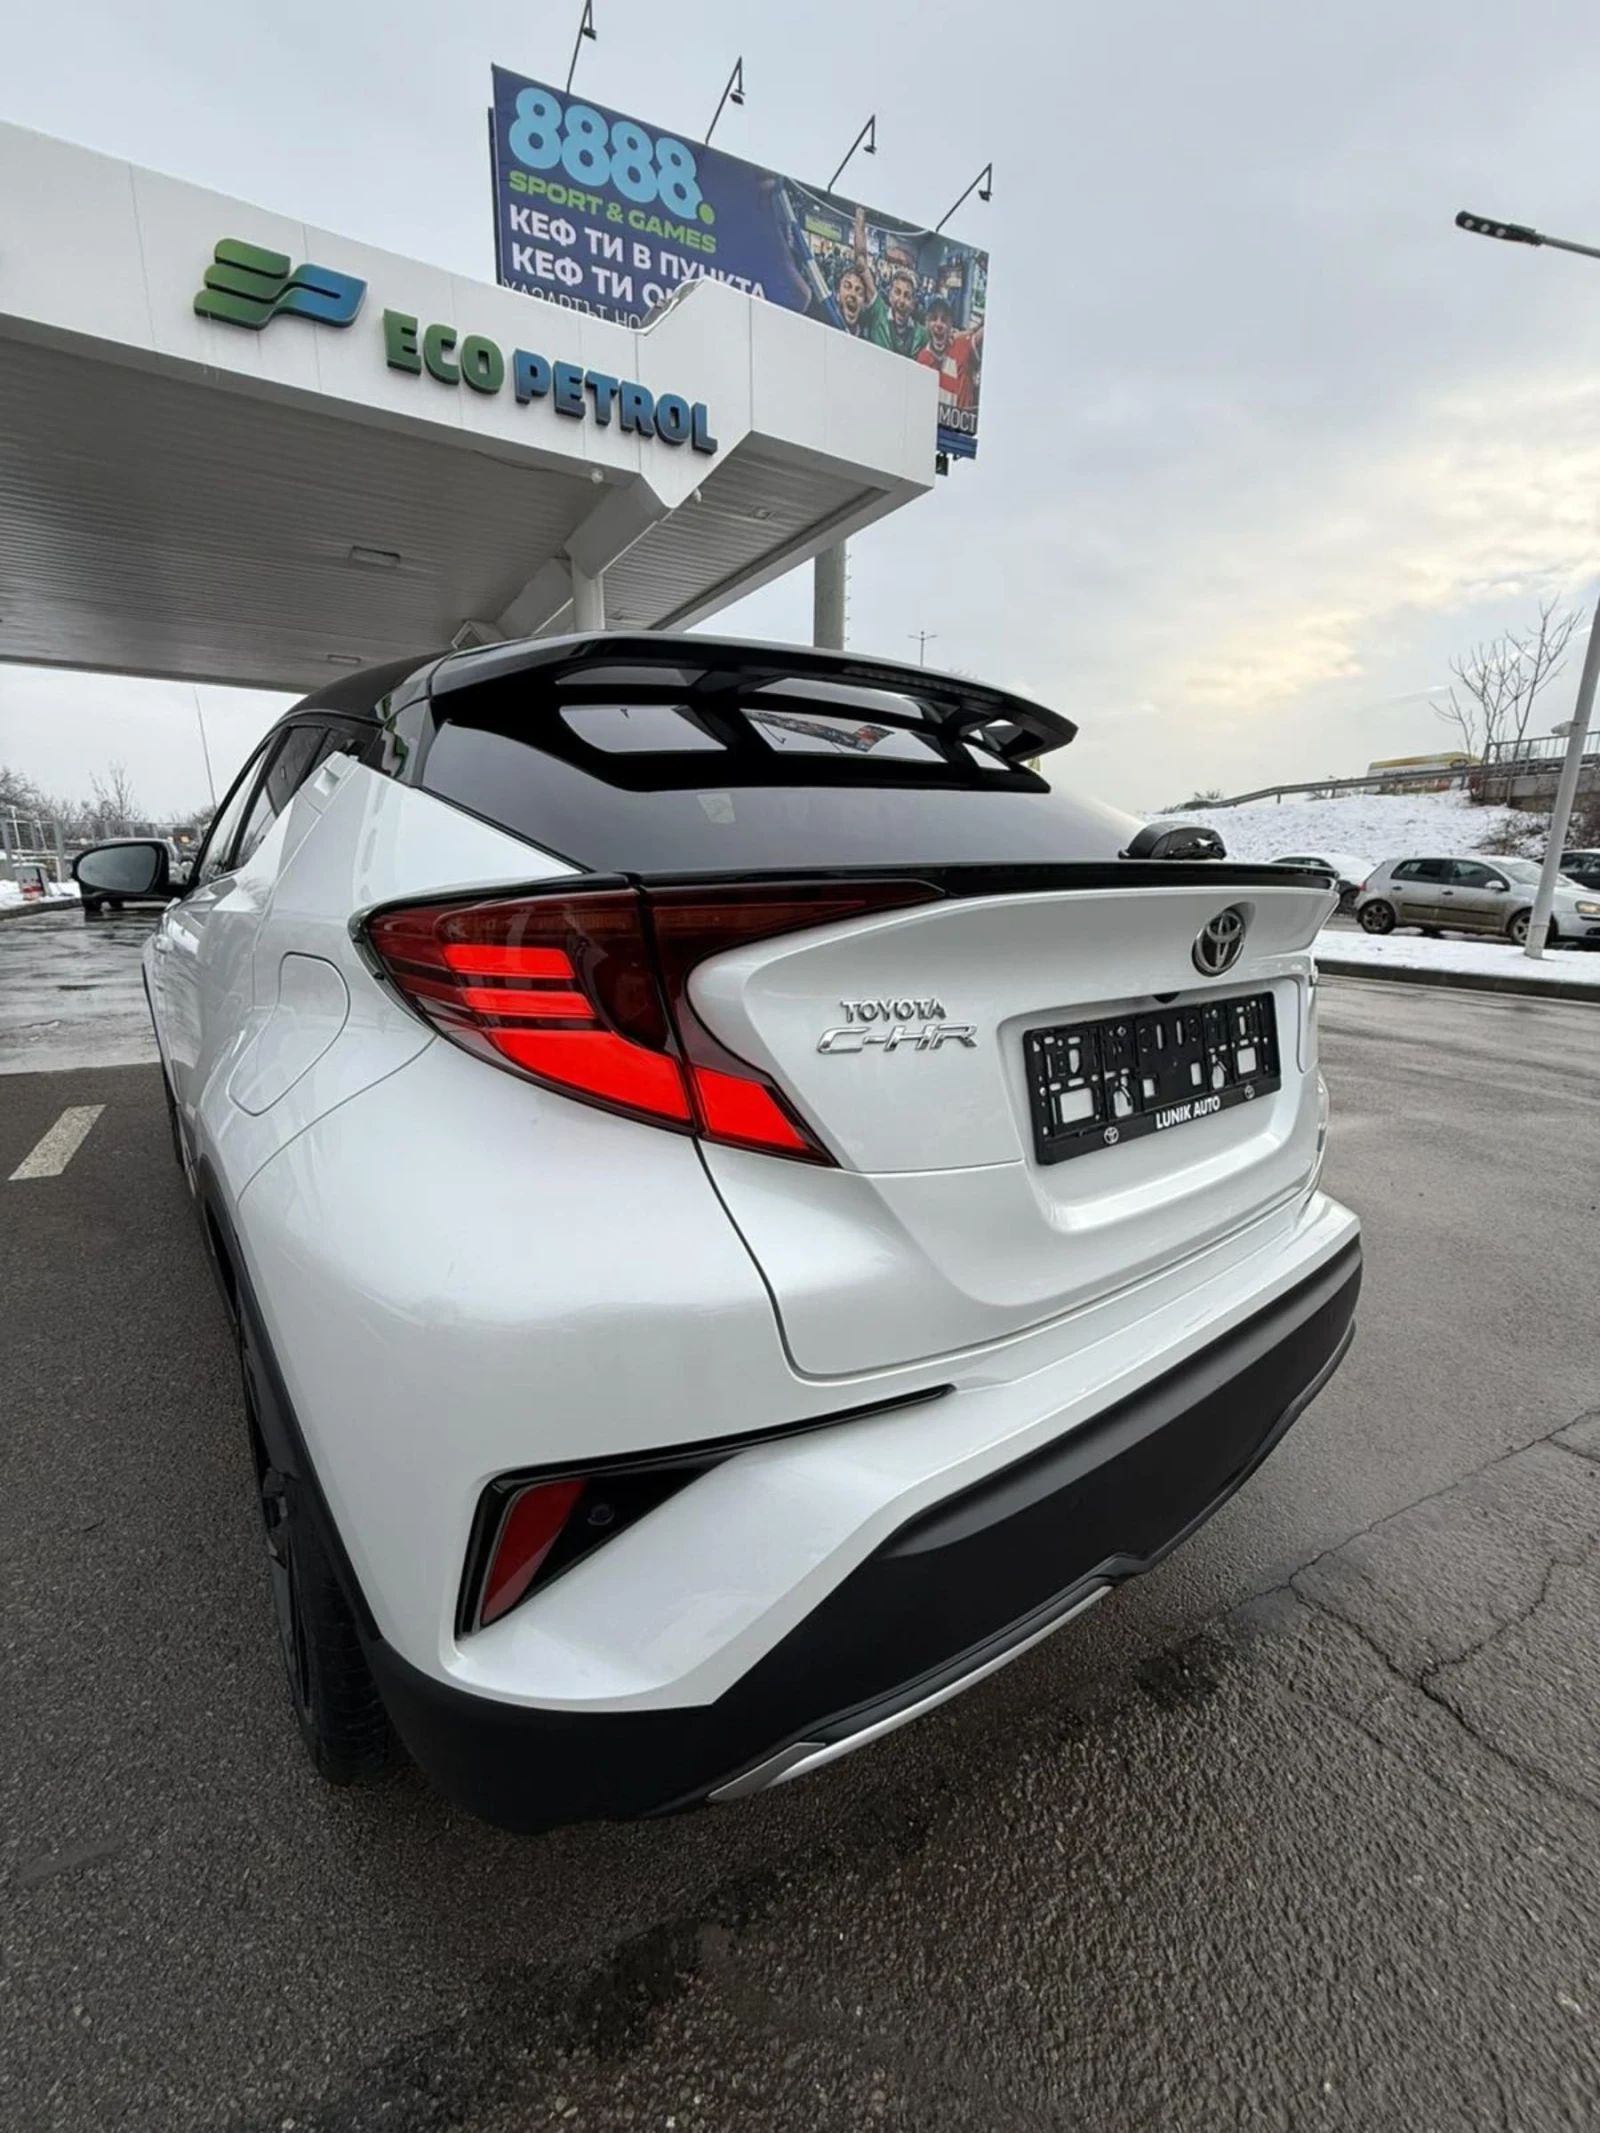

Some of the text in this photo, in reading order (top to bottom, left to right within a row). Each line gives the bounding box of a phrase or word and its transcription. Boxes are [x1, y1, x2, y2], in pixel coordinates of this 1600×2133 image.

[509, 173, 716, 254] SPORT & GAMES
[510, 203, 577, 247] КЕФ
[584, 226, 624, 262] ТИ
[632, 241, 652, 270] В
[511, 241, 584, 287] КЕФ
[591, 265, 633, 302] ТИ
[840, 998, 947, 1024] TOYOTA
[816, 1023, 978, 1054] C-HR
[1155, 1095, 1221, 1129] LUNIK AUTO
